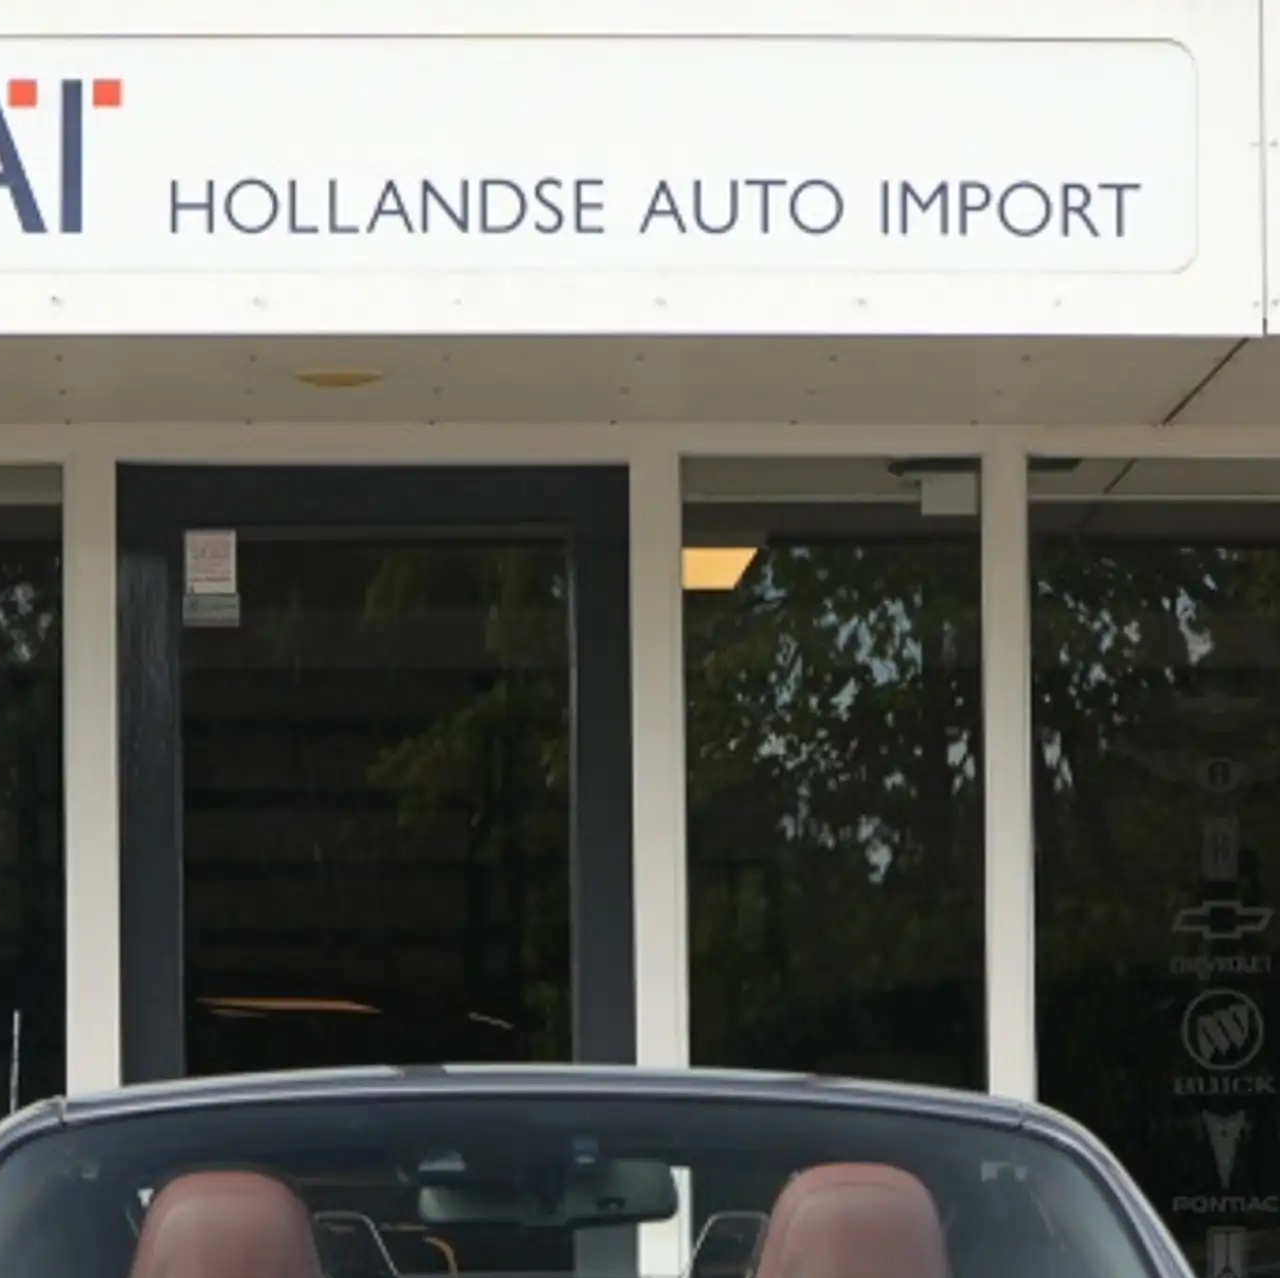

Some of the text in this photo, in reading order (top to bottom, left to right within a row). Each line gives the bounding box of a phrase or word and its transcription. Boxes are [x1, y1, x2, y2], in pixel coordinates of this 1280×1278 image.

[169, 177, 1142, 238] HOLLANDSE AUTO IMPORT
[1172, 1075, 1277, 1096] BUICK
[1171, 1195, 1280, 1213] PONTIAC
